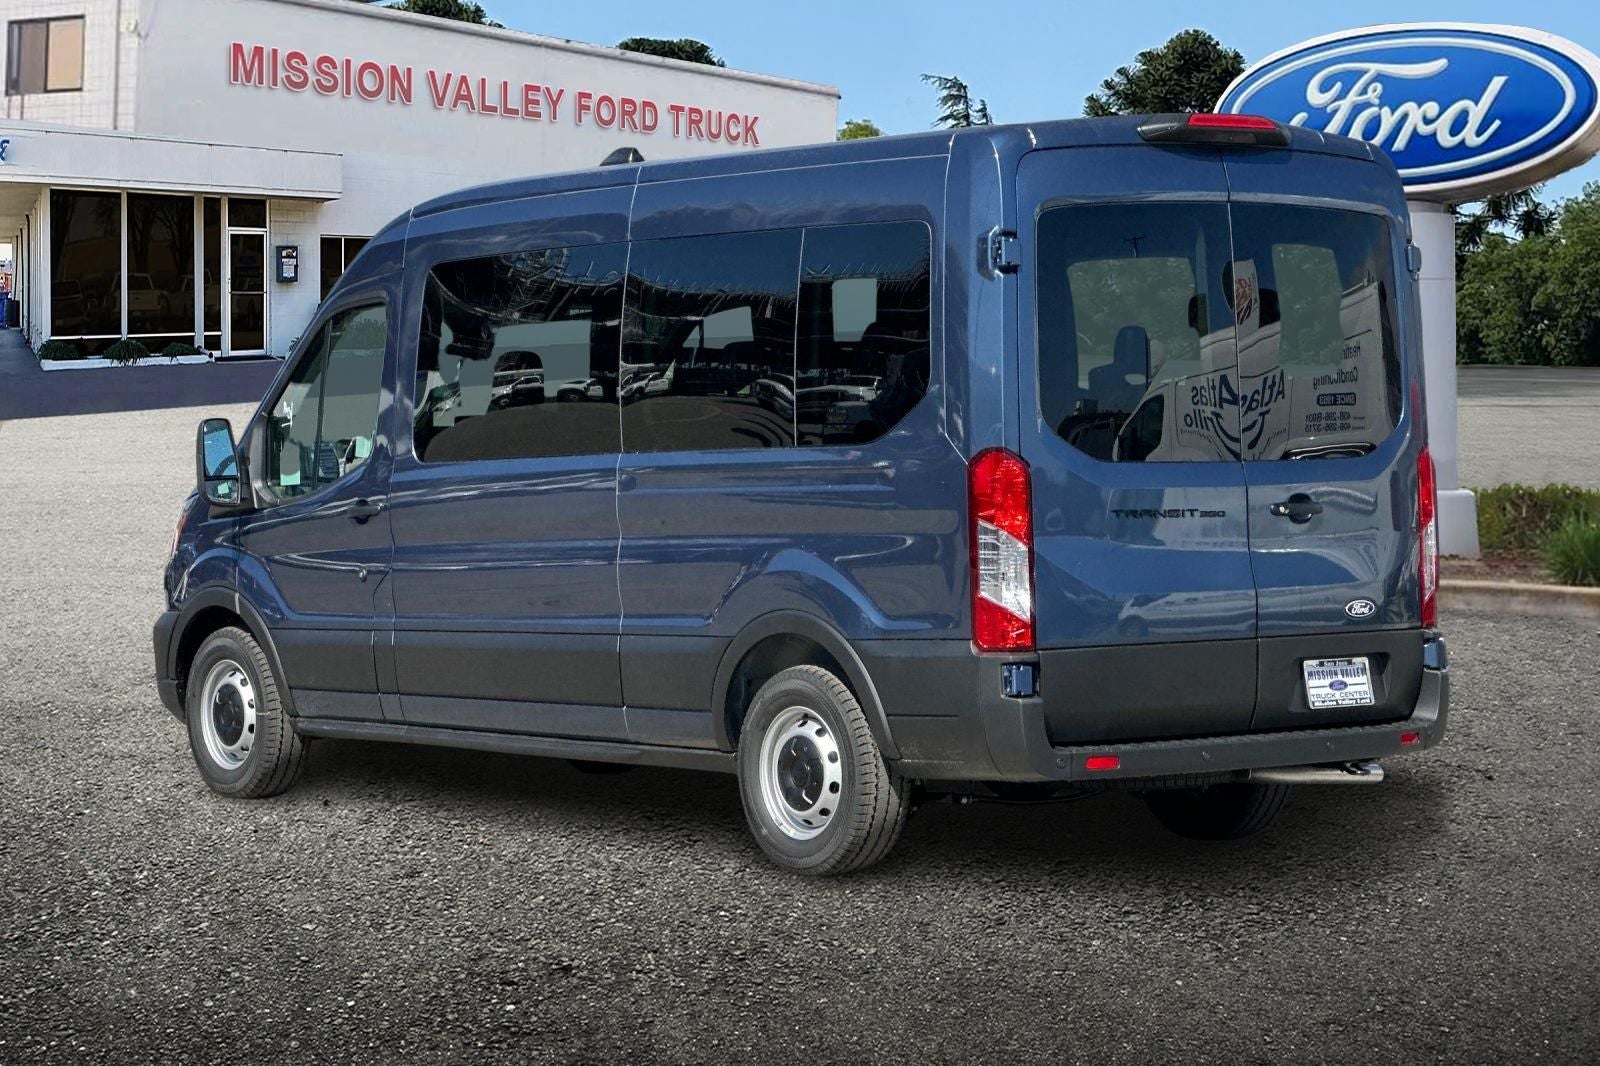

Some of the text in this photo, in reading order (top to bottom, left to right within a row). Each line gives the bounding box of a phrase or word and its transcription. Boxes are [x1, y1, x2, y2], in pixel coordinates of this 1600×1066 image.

[228, 40, 761, 147] MISSION VALLEY FORD TRUCK
[1290, 57, 1510, 152] Ford
[1351, 602, 1371, 614] Ford
[1307, 666, 1366, 681] MISSION VALLEY
[1311, 690, 1369, 700] TRUCK CENTER
